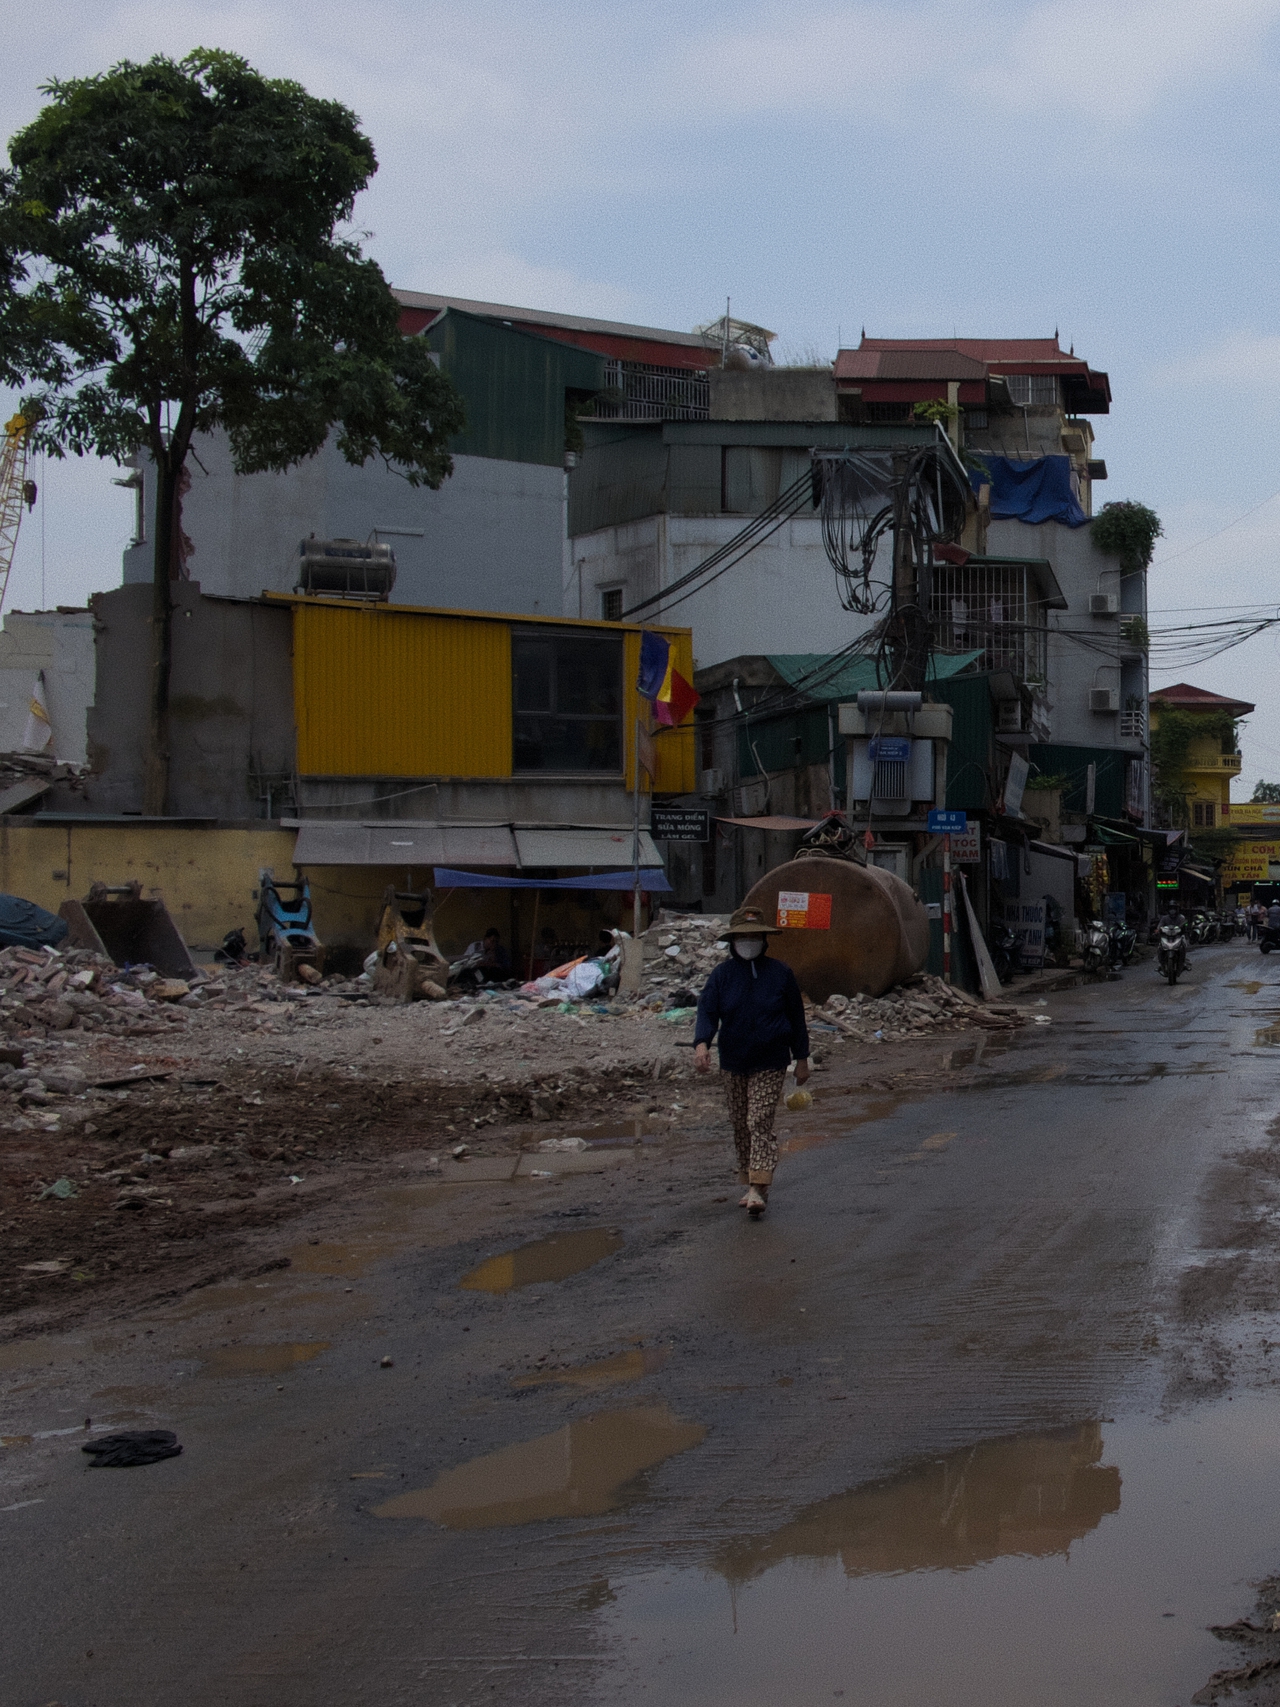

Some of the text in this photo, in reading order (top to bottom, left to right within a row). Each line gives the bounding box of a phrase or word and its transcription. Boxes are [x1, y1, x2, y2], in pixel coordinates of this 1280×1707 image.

[654, 813, 683, 821] TRANG
[953, 838, 977, 847] TÓC
[1251, 845, 1275, 854] CƠM
[952, 850, 979, 858] NAM
